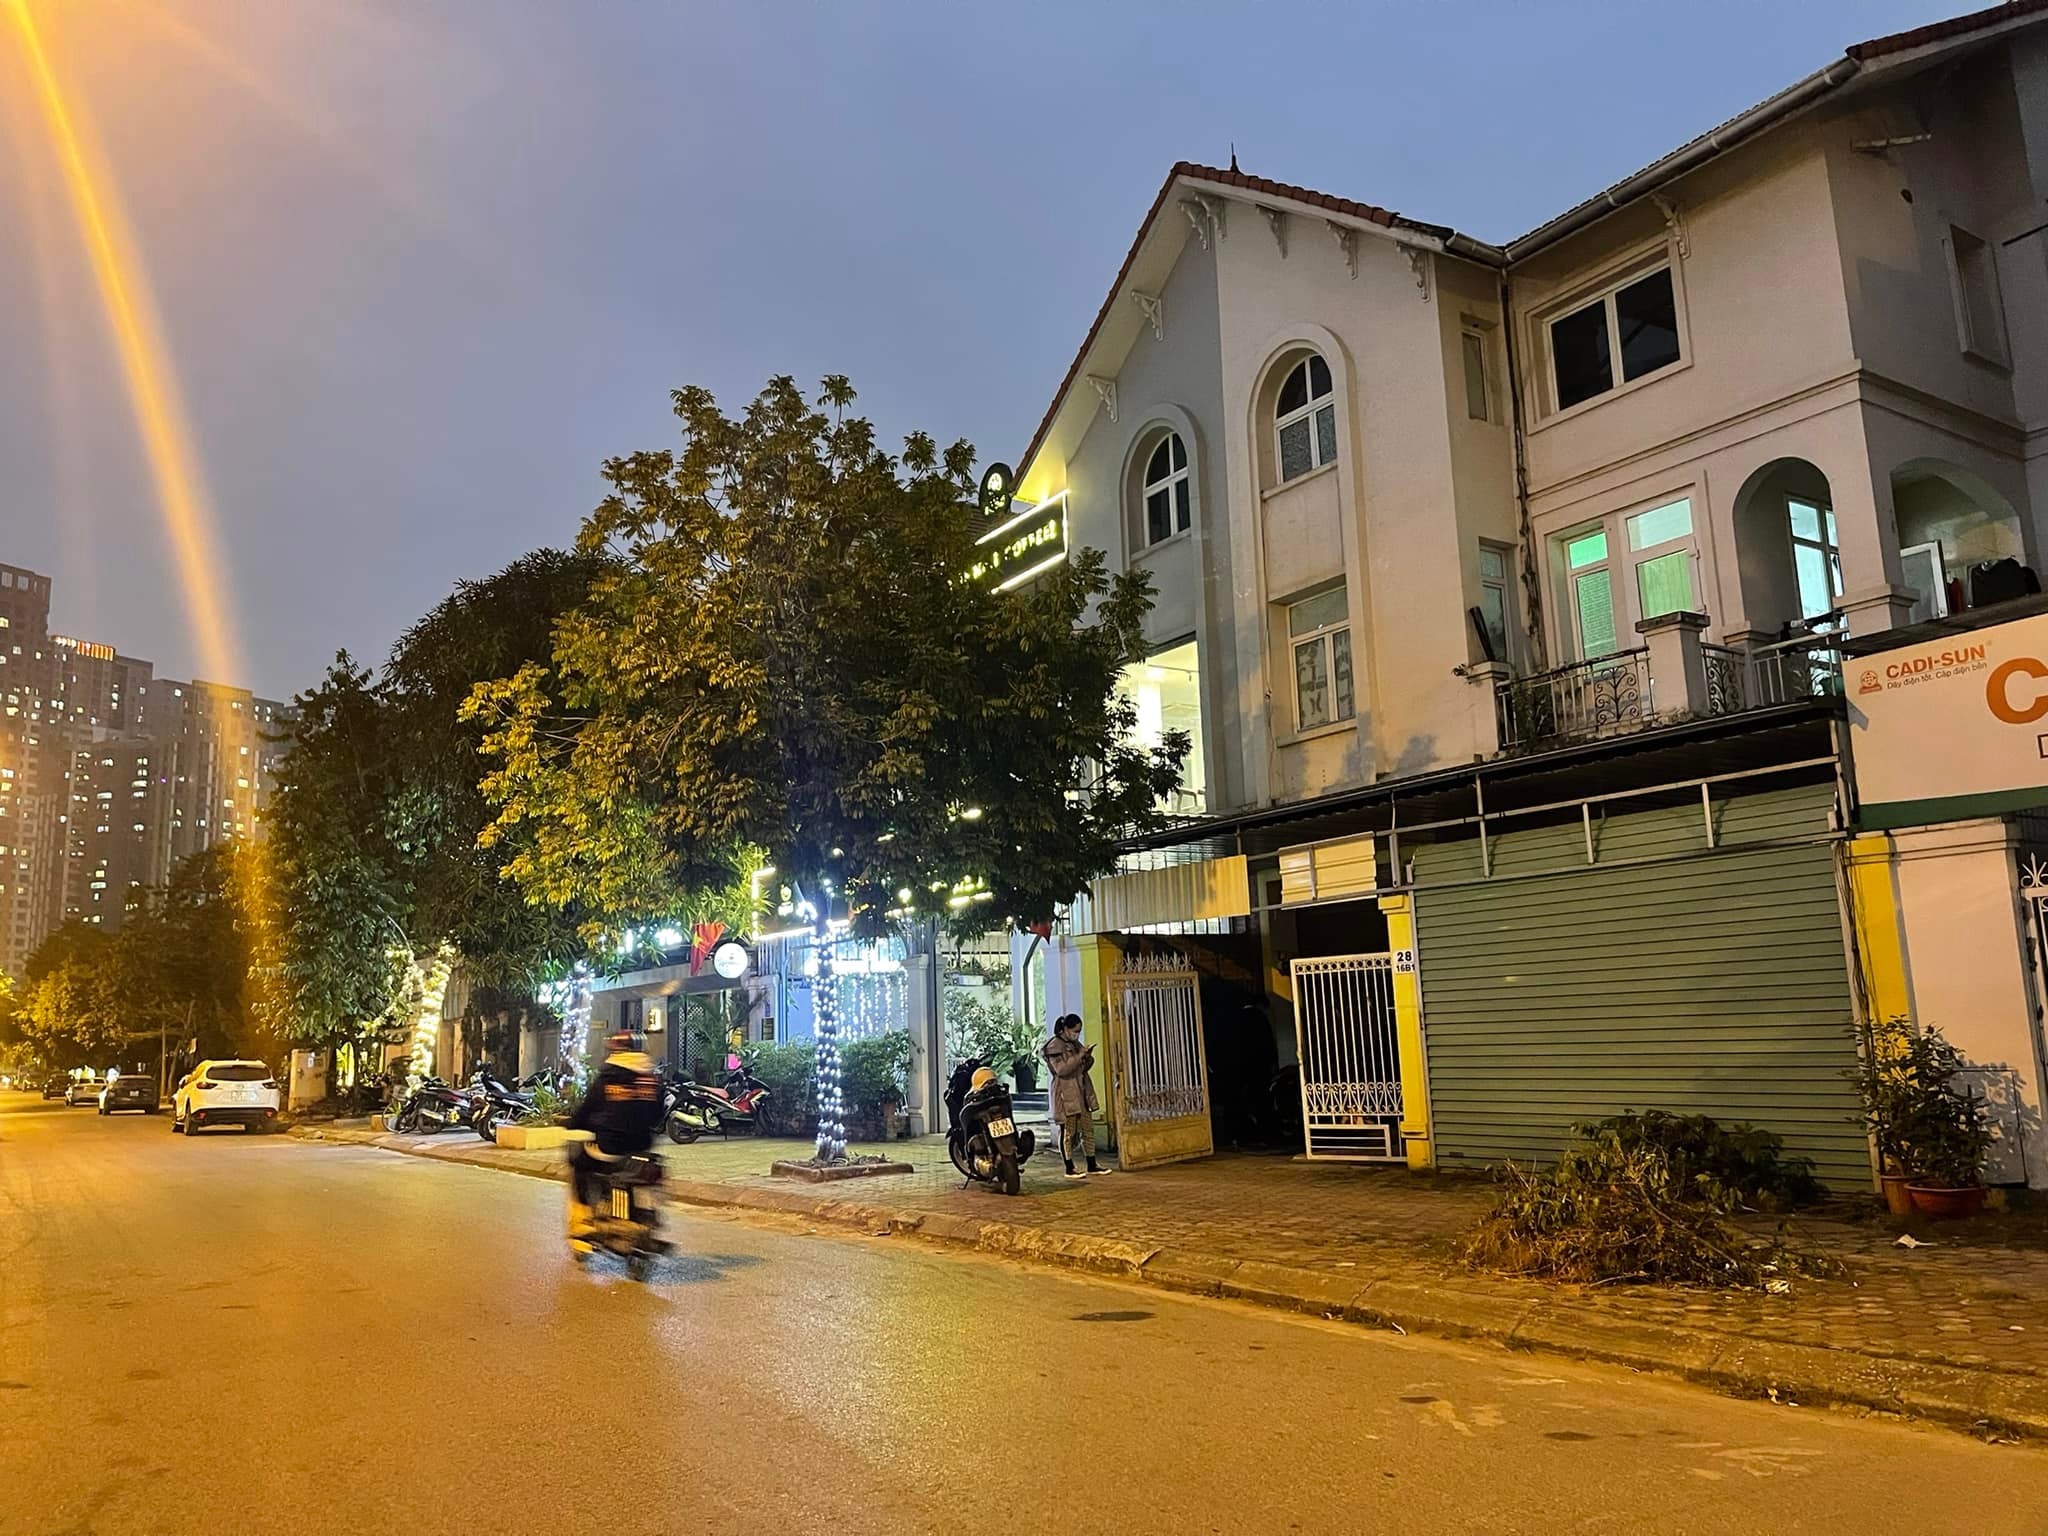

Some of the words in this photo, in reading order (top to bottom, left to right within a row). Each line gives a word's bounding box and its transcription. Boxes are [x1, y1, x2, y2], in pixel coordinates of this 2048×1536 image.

[1886, 644, 1985, 679] CADI-SUN
[1887, 679, 1902, 690] Dây
[1903, 675, 1920, 686] điện
[1953, 664, 1970, 675] điện
[1396, 951, 1412, 962] 28
